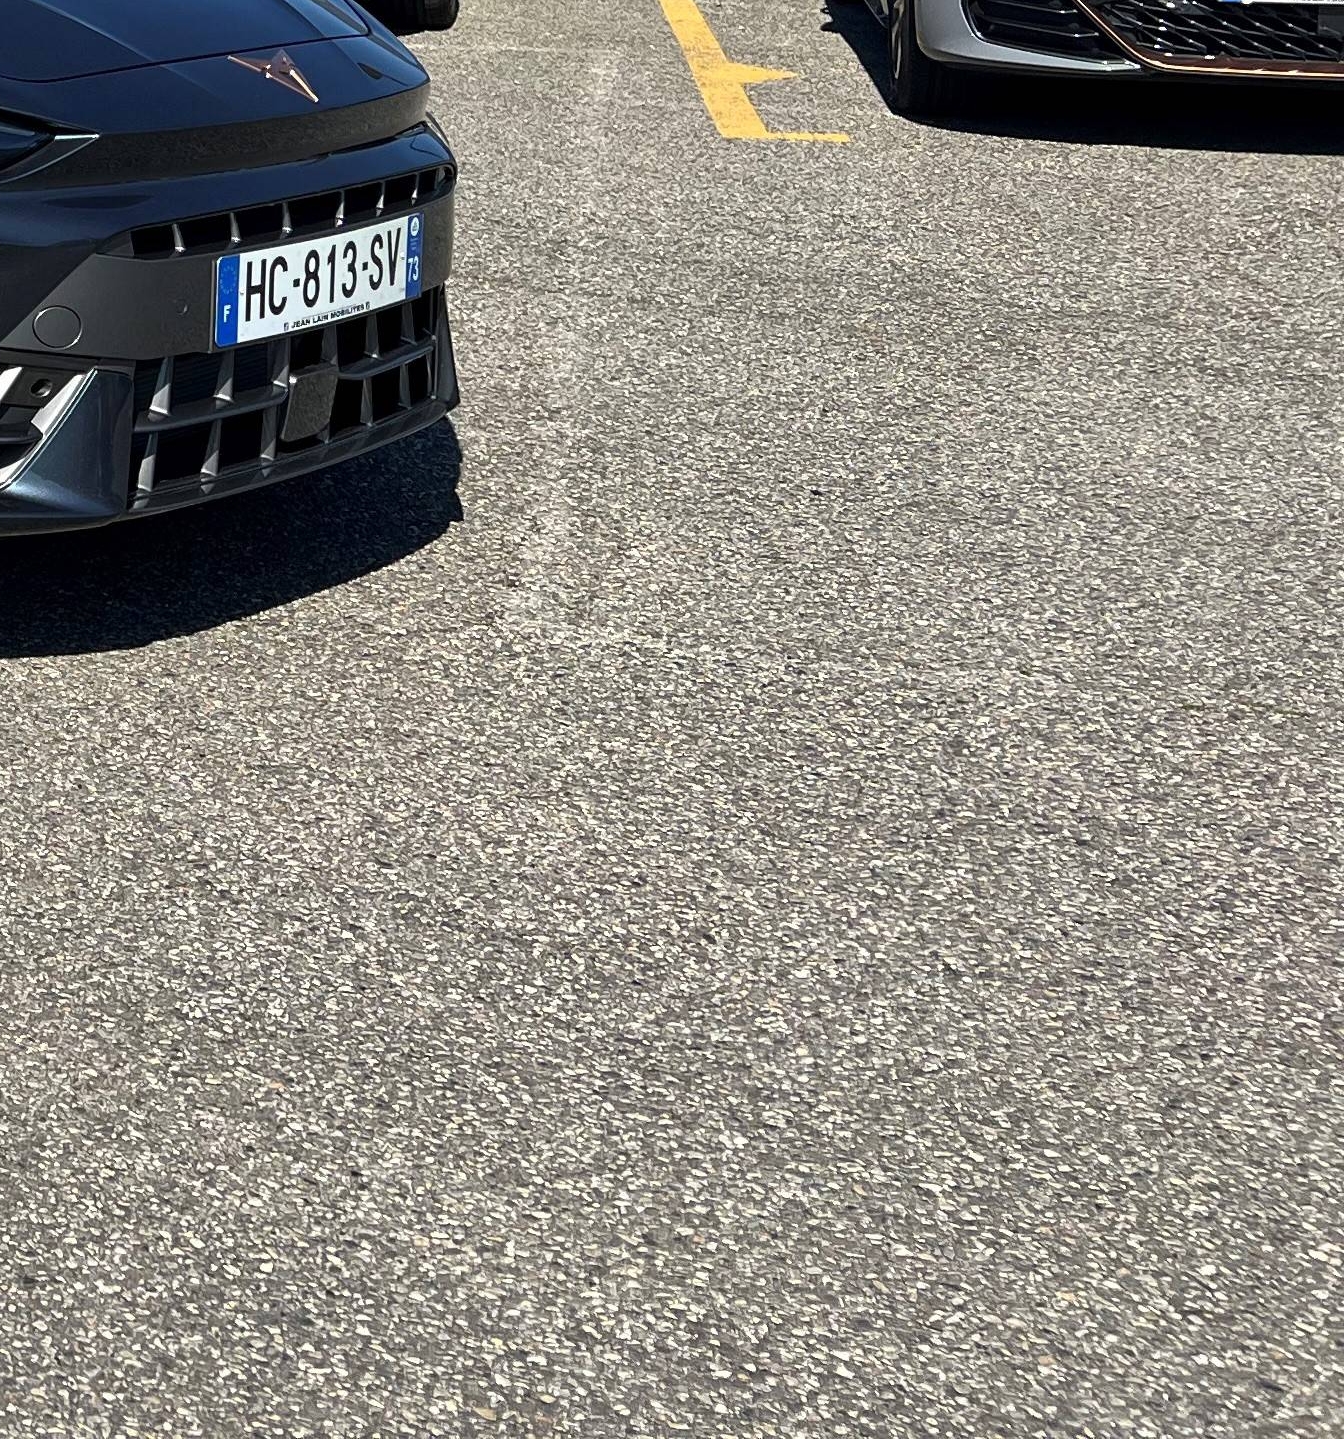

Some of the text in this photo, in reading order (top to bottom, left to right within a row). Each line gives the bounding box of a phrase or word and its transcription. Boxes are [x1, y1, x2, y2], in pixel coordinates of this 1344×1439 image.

[244, 226, 402, 323] HC-813-SV
[407, 255, 419, 282] 73
[223, 304, 231, 323] F
[291, 318, 311, 329] JEAN
